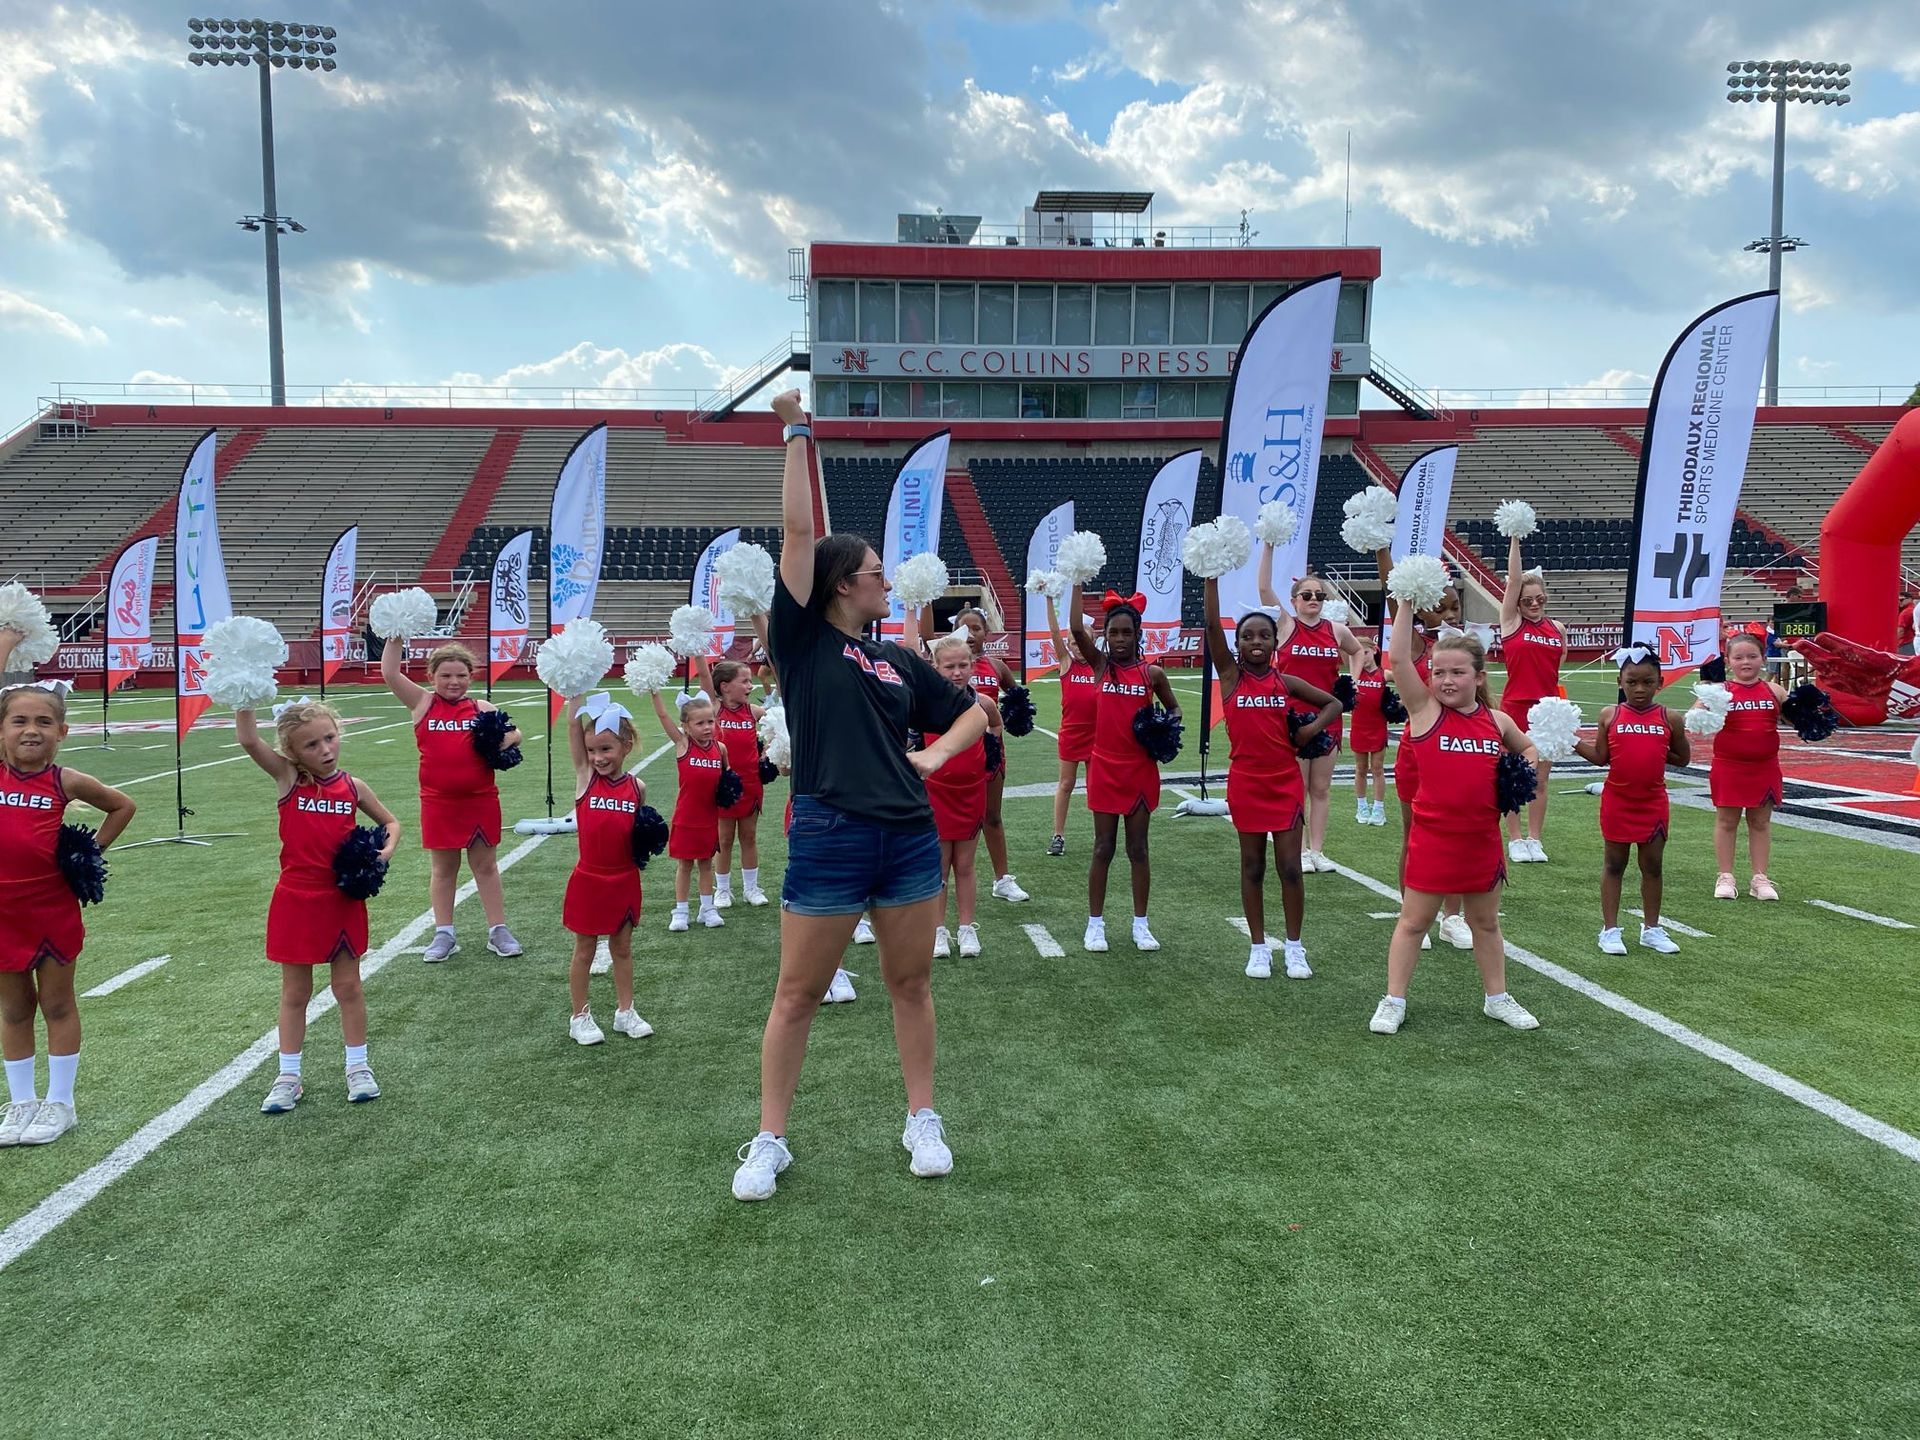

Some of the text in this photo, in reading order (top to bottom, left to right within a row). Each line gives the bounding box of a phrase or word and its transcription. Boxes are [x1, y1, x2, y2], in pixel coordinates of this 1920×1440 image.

[899, 350, 949, 373] C.C.
[960, 350, 1090, 374] COLLINS
[1121, 351, 1209, 374] PRESS
[147, 405, 157, 418] A
[384, 408, 393, 420] B
[654, 410, 664, 422] C
[1470, 409, 1479, 422] G
[1677, 325, 1717, 523] THIBODAUX REGIONAL
[1695, 325, 1734, 524] SPORTS MEDICINE CENTER
[1300, 437, 1313, 491] Assurance
[1255, 404, 1305, 546] S&H
[1295, 492, 1307, 521] Total
[1420, 497, 1432, 536] MEDICINE
[1426, 462, 1436, 496] CENTER
[1410, 461, 1428, 557] BODAUX REGIONAL
[1143, 517, 1157, 576] LA TOUR
[340, 565, 352, 593] ENT
[495, 559, 510, 612] JOE'S
[505, 551, 527, 625] Signs
[1523, 632, 1562, 647] EAGLES
[1291, 644, 1339, 658] EAGLES
[969, 675, 998, 686] GLES
[1070, 674, 1096, 684] EAGLE
[1102, 682, 1146, 697] EAGLES
[1236, 695, 1286, 708] EAGLES
[1728, 700, 1775, 711] EAGLES
[720, 720, 753, 730] EAGLES
[1616, 723, 1666, 736] EAGLES
[1440, 735, 1500, 755] EAGLES
[689, 757, 722, 769] EAGLES
[0, 790, 53, 810] AGLES
[297, 796, 353, 815] EAGLES
[588, 796, 636, 814] EAGLES
